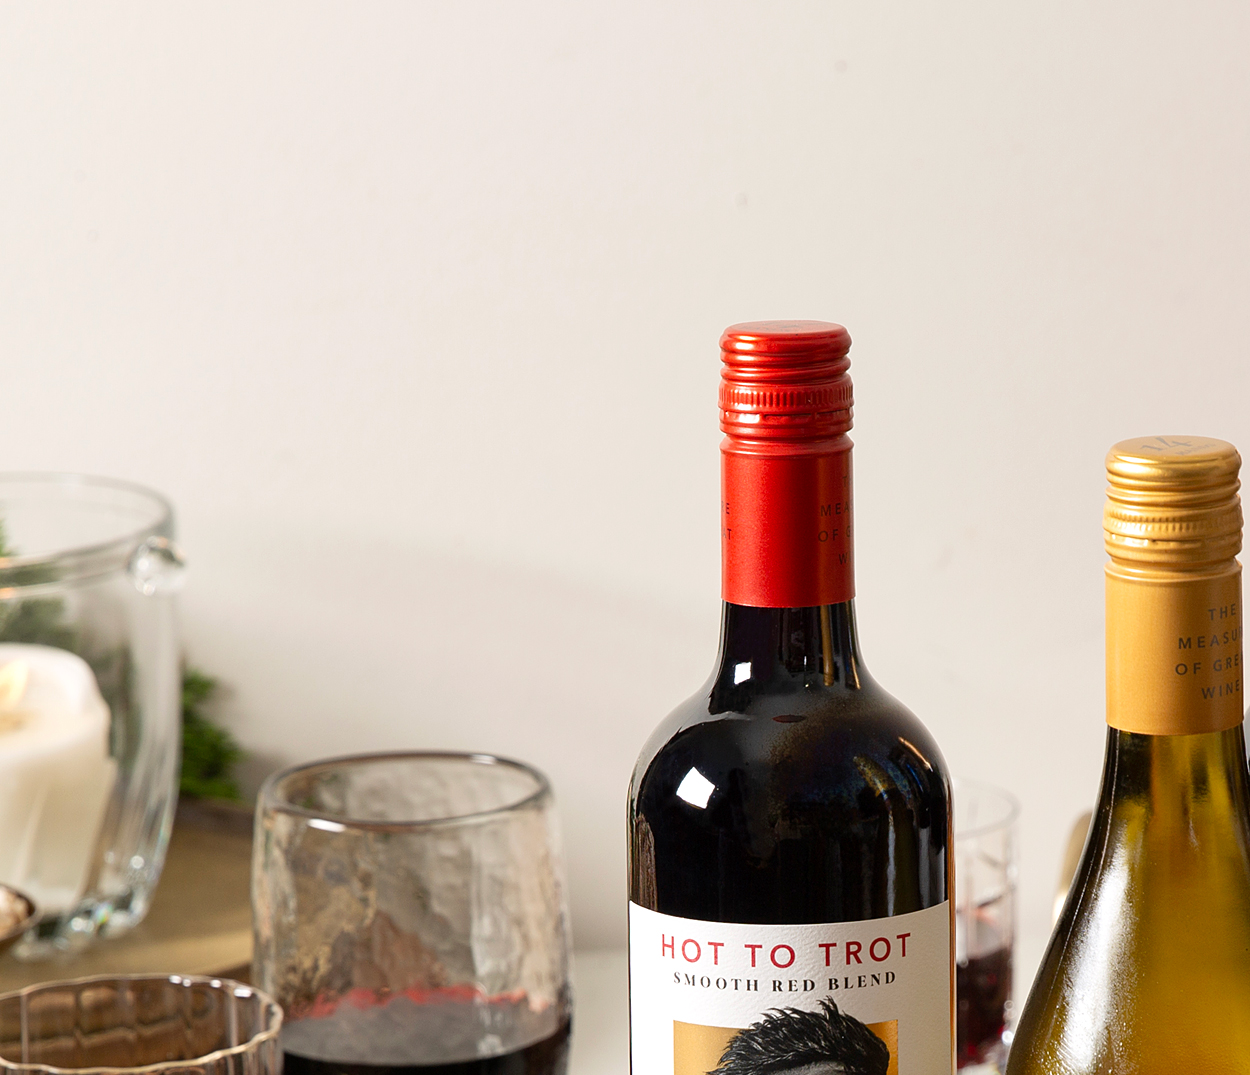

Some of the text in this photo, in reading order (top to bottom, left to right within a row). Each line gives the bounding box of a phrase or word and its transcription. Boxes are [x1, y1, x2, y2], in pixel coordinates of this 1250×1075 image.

[1208, 603, 1236, 620] THE
[1175, 653, 1242, 675] OF GRE
[1201, 679, 1240, 699] WINE
[661, 931, 912, 969] HOT TO TROT
[673, 970, 897, 992] SMOOTH RED BLEND
